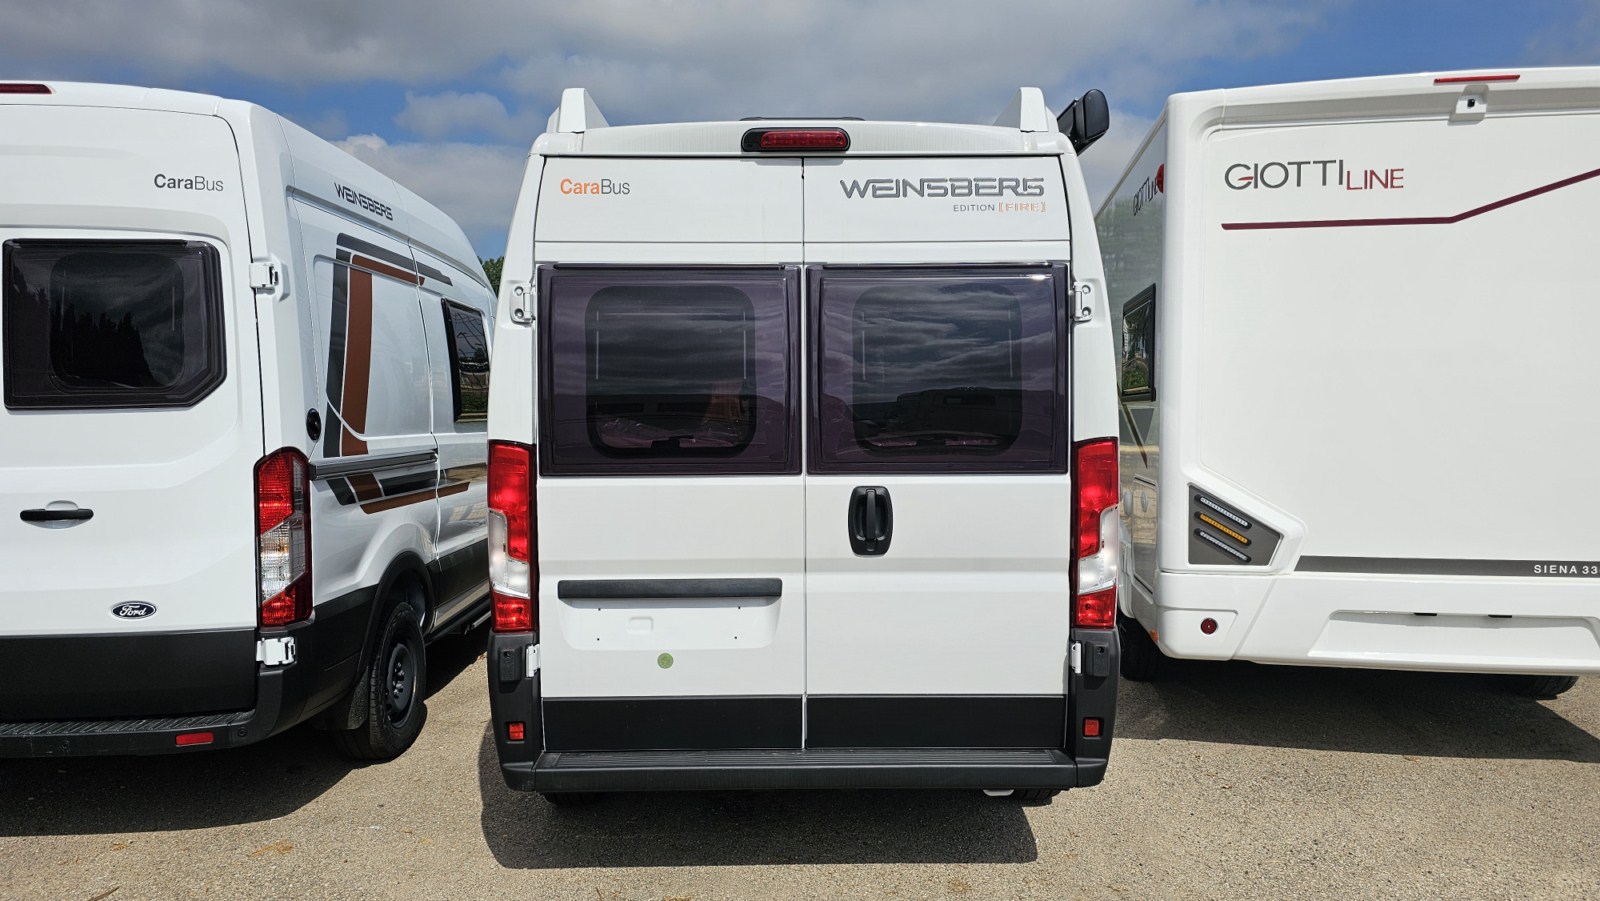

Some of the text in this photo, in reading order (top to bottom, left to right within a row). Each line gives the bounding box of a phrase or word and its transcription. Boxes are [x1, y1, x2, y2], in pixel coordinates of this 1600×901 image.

[153, 173, 224, 192] CaraBus
[560, 178, 631, 195] CaraBus
[839, 177, 1045, 199] WEINSBERG
[333, 181, 394, 221] WEINSBERG
[953, 204, 996, 212] EDITION
[1533, 564, 1600, 575] SIENA 33
[119, 604, 148, 616] Ford
